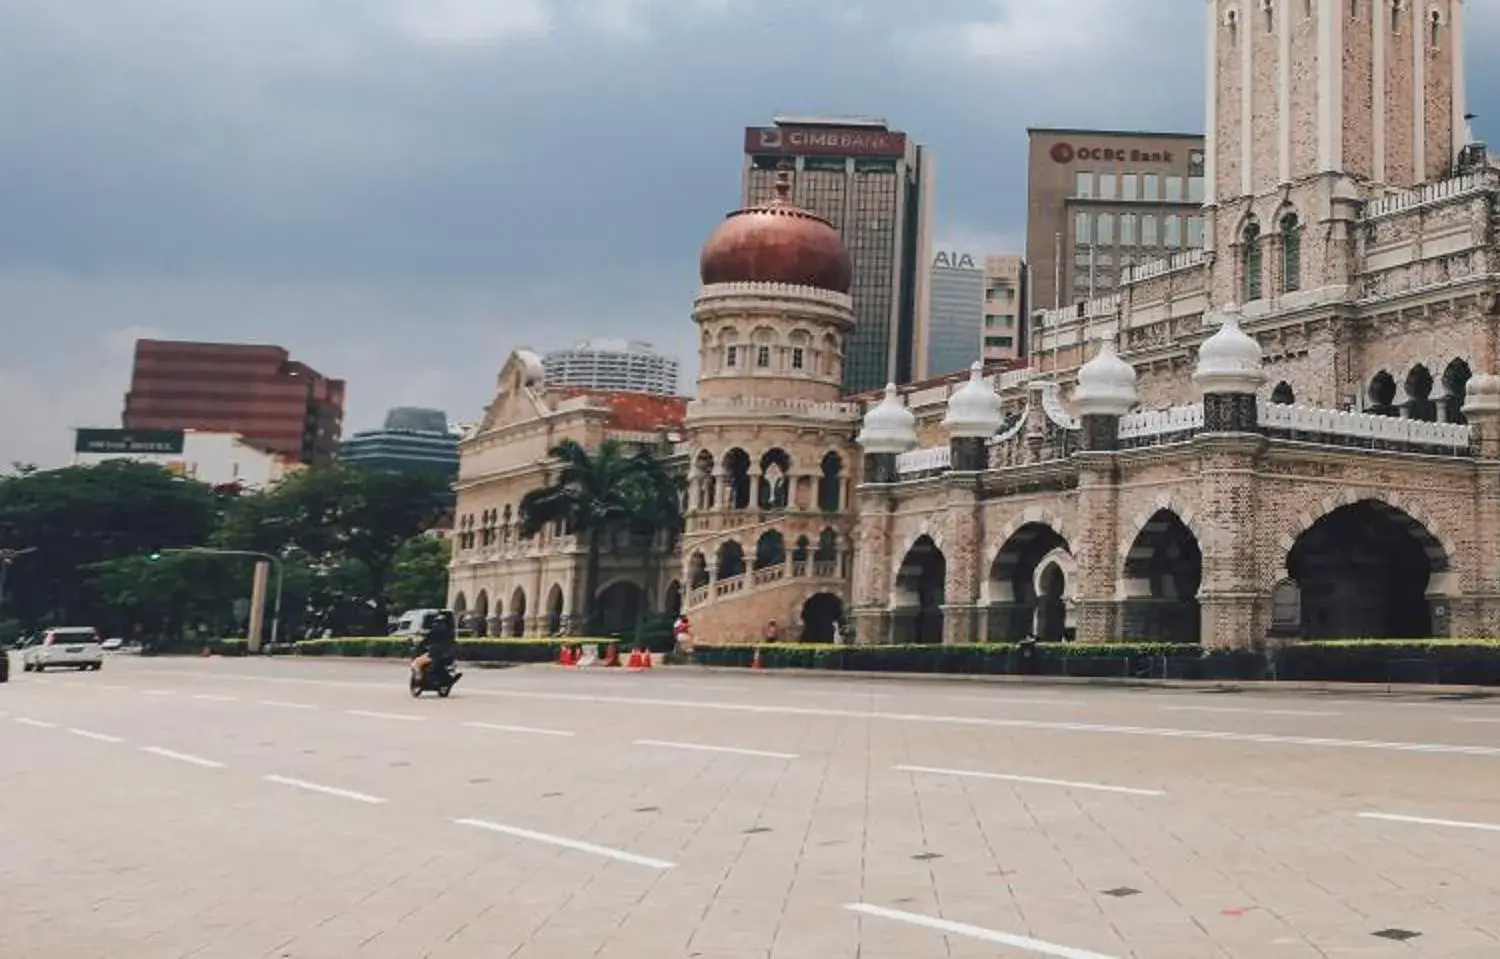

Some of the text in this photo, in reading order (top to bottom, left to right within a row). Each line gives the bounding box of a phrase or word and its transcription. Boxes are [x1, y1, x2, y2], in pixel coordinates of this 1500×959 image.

[788, 130, 889, 149] CIMB BANK
[1077, 147, 1174, 163] OCBC Bank
[933, 251, 975, 269] AIA
